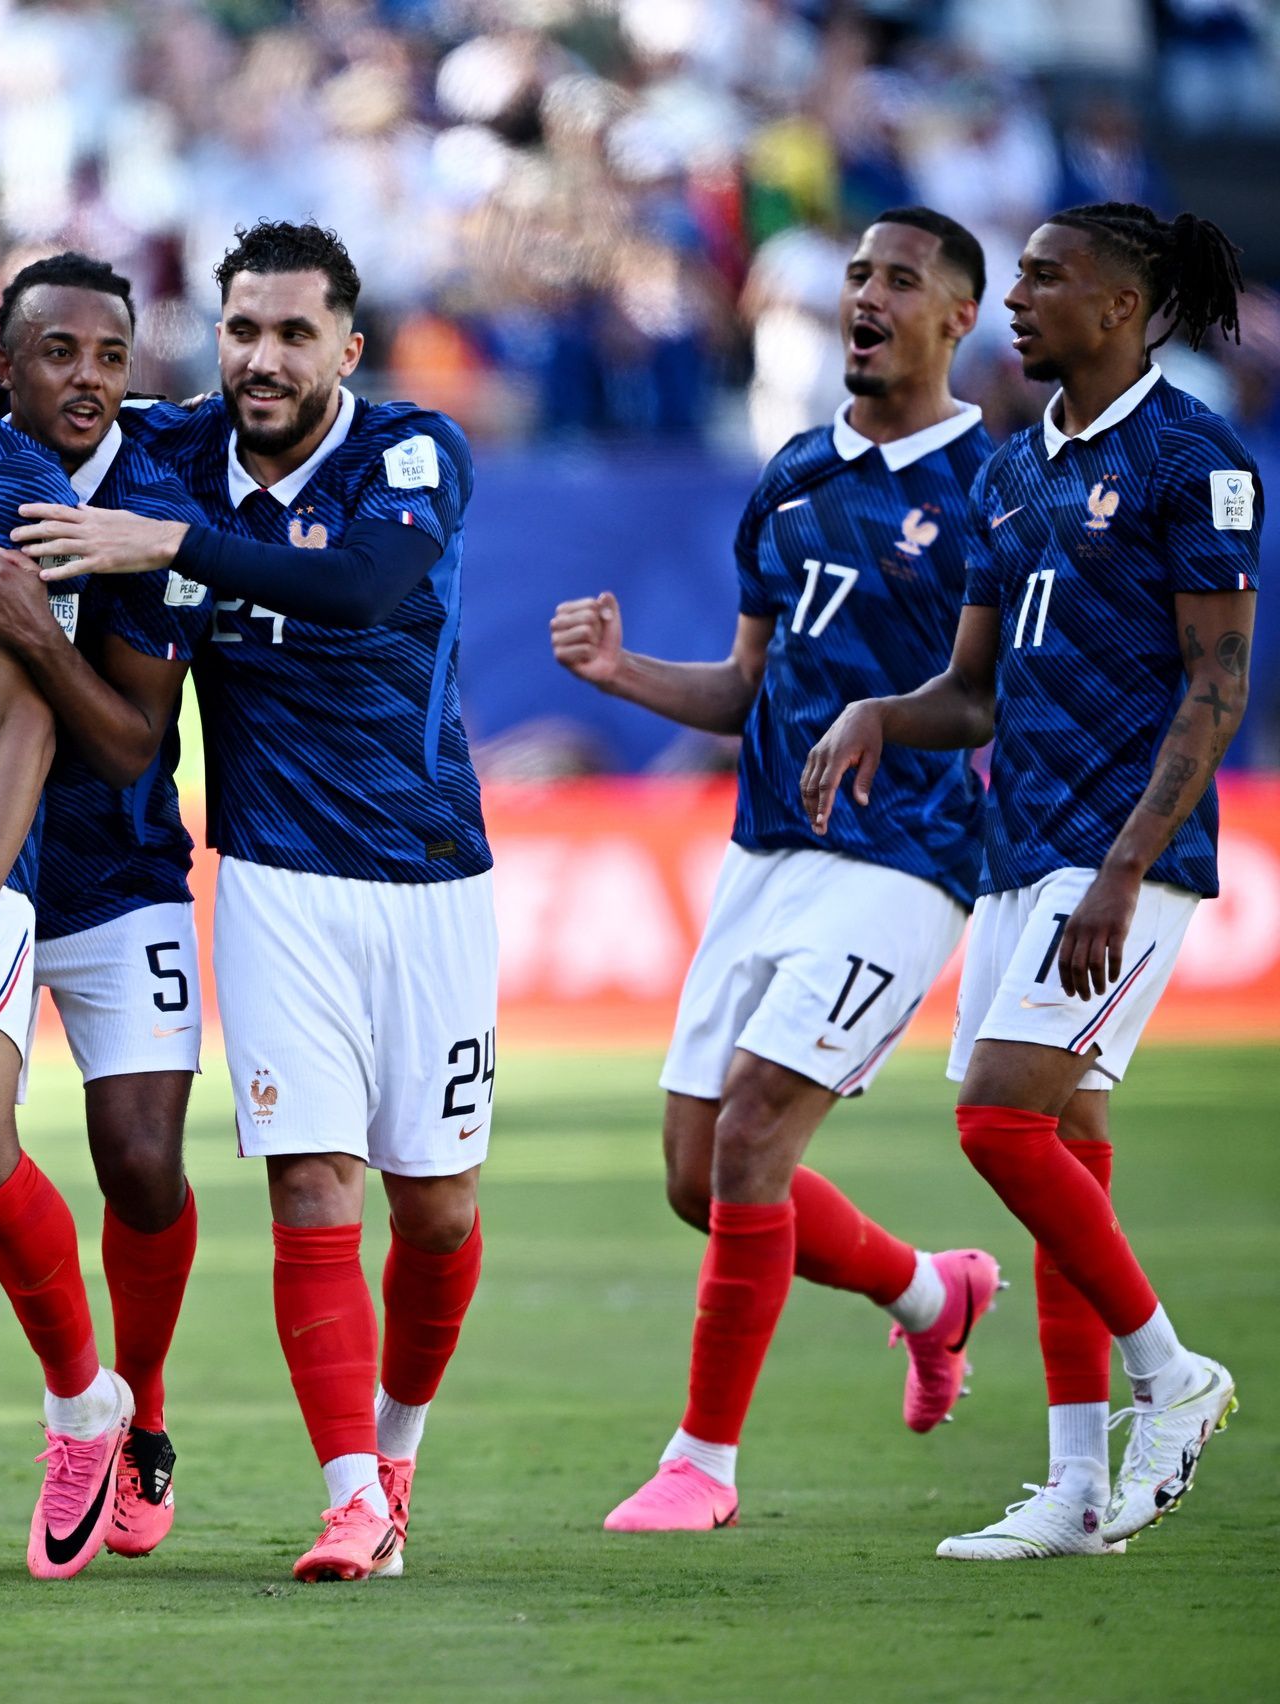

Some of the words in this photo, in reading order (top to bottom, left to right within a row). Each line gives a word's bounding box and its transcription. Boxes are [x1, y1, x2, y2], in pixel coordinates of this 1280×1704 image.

[402, 466, 424, 476] PEACE
[1226, 507, 1243, 516] PEACE
[180, 583, 199, 594] PEACE
[790, 558, 859, 638] 17
[1013, 569, 1055, 648] 11
[144, 941, 189, 1013] 5
[827, 953, 896, 1032] 17
[441, 1025, 496, 1119] 24
